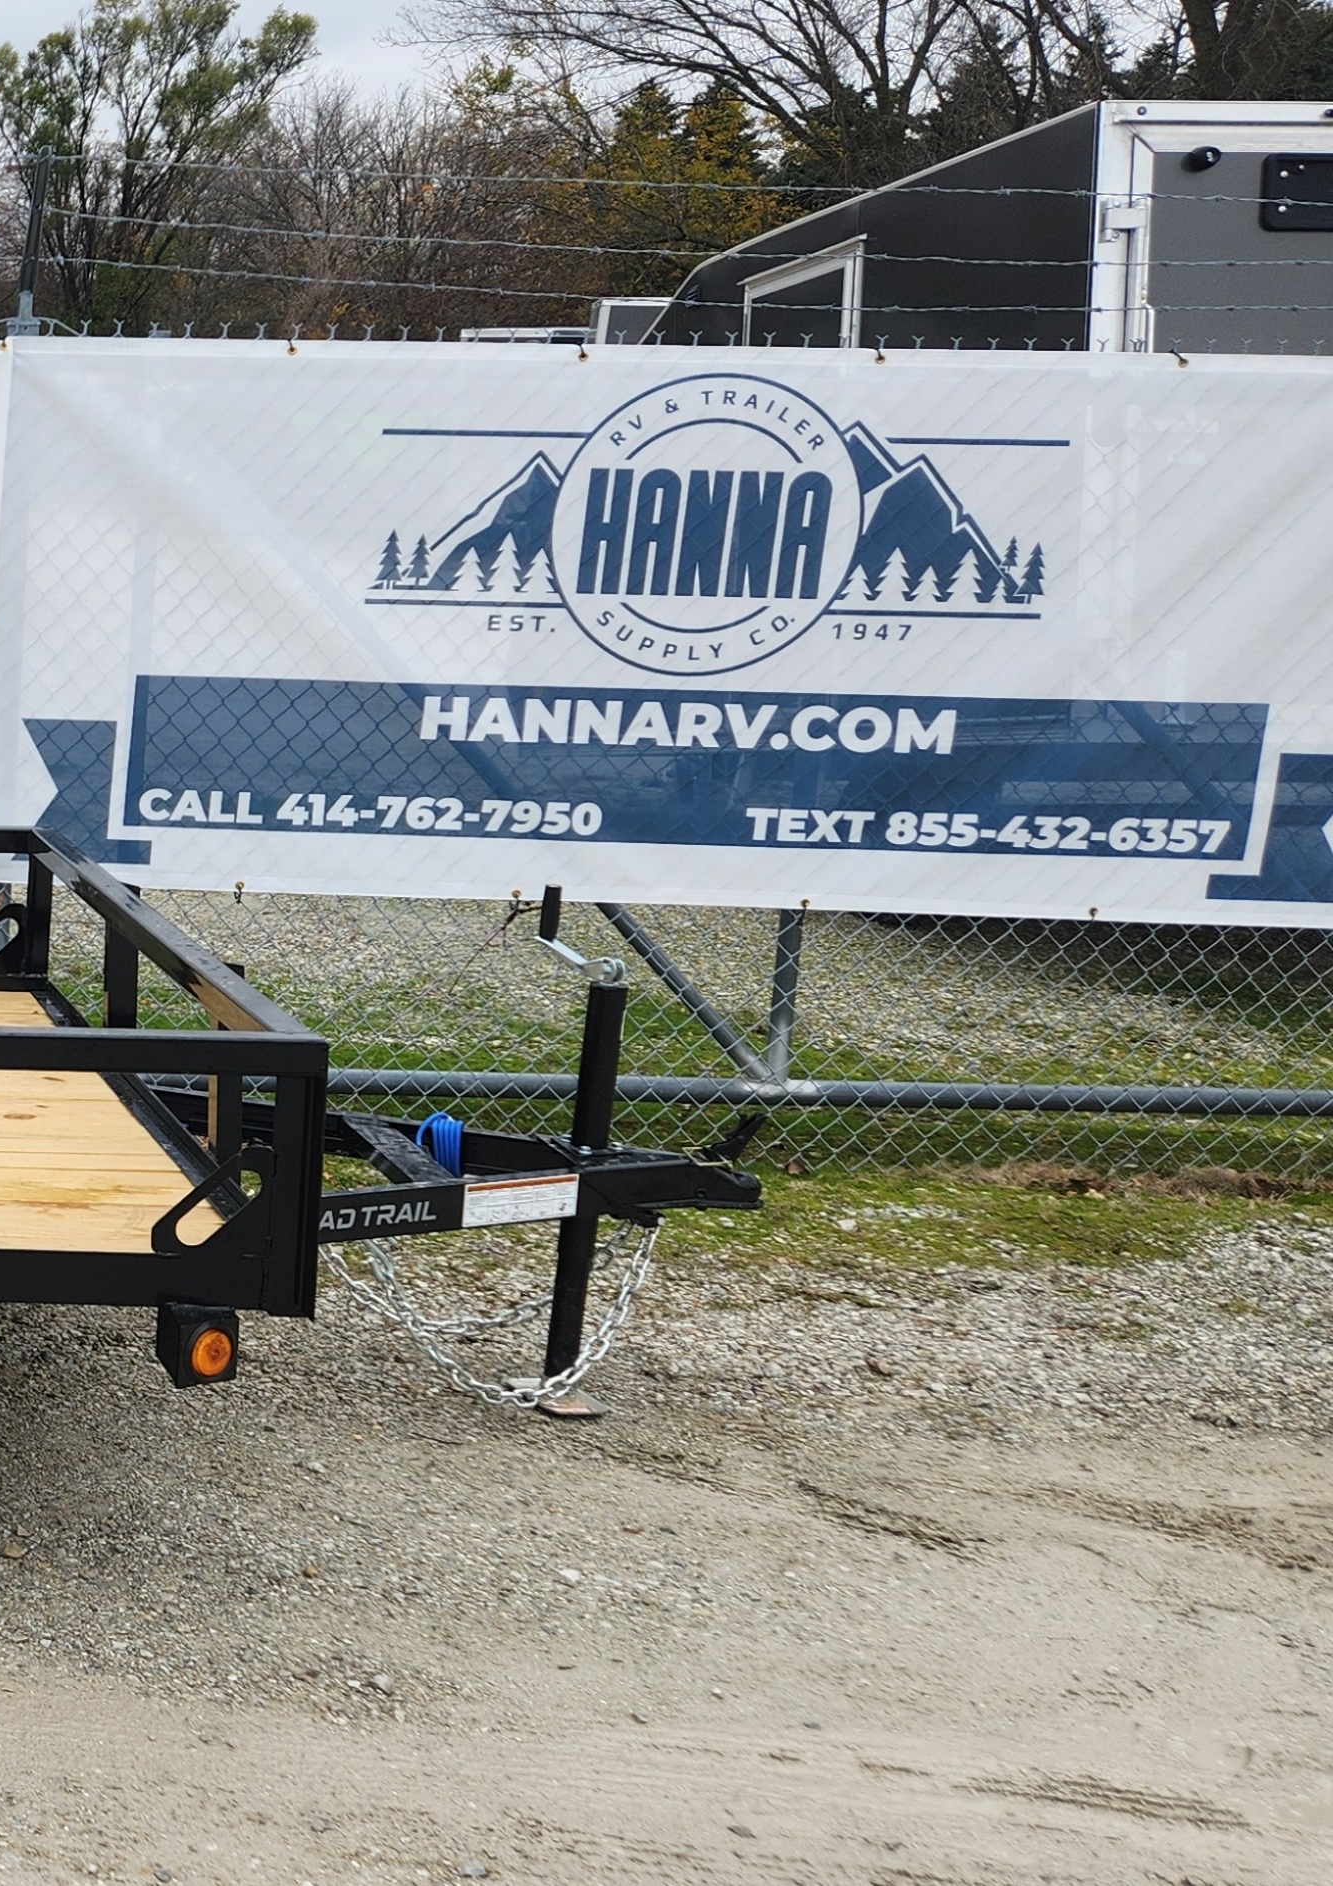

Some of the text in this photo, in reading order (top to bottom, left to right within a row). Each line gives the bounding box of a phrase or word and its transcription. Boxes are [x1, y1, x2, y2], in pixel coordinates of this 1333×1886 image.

[609, 389, 826, 451] RV & TRAILER
[575, 467, 833, 600] HANNA
[487, 614, 556, 633] EST.
[596, 610, 724, 661] SUPPLY
[749, 614, 795, 646] CO.
[832, 622, 913, 642] 1947
[419, 695, 958, 755] HANNARV.COM
[138, 788, 603, 836] CALL 414-762-7950
[745, 807, 1231, 854] TEXT 855-432-6357
[319, 1208, 357, 1231] AD
[361, 1201, 437, 1228] TRAIL
